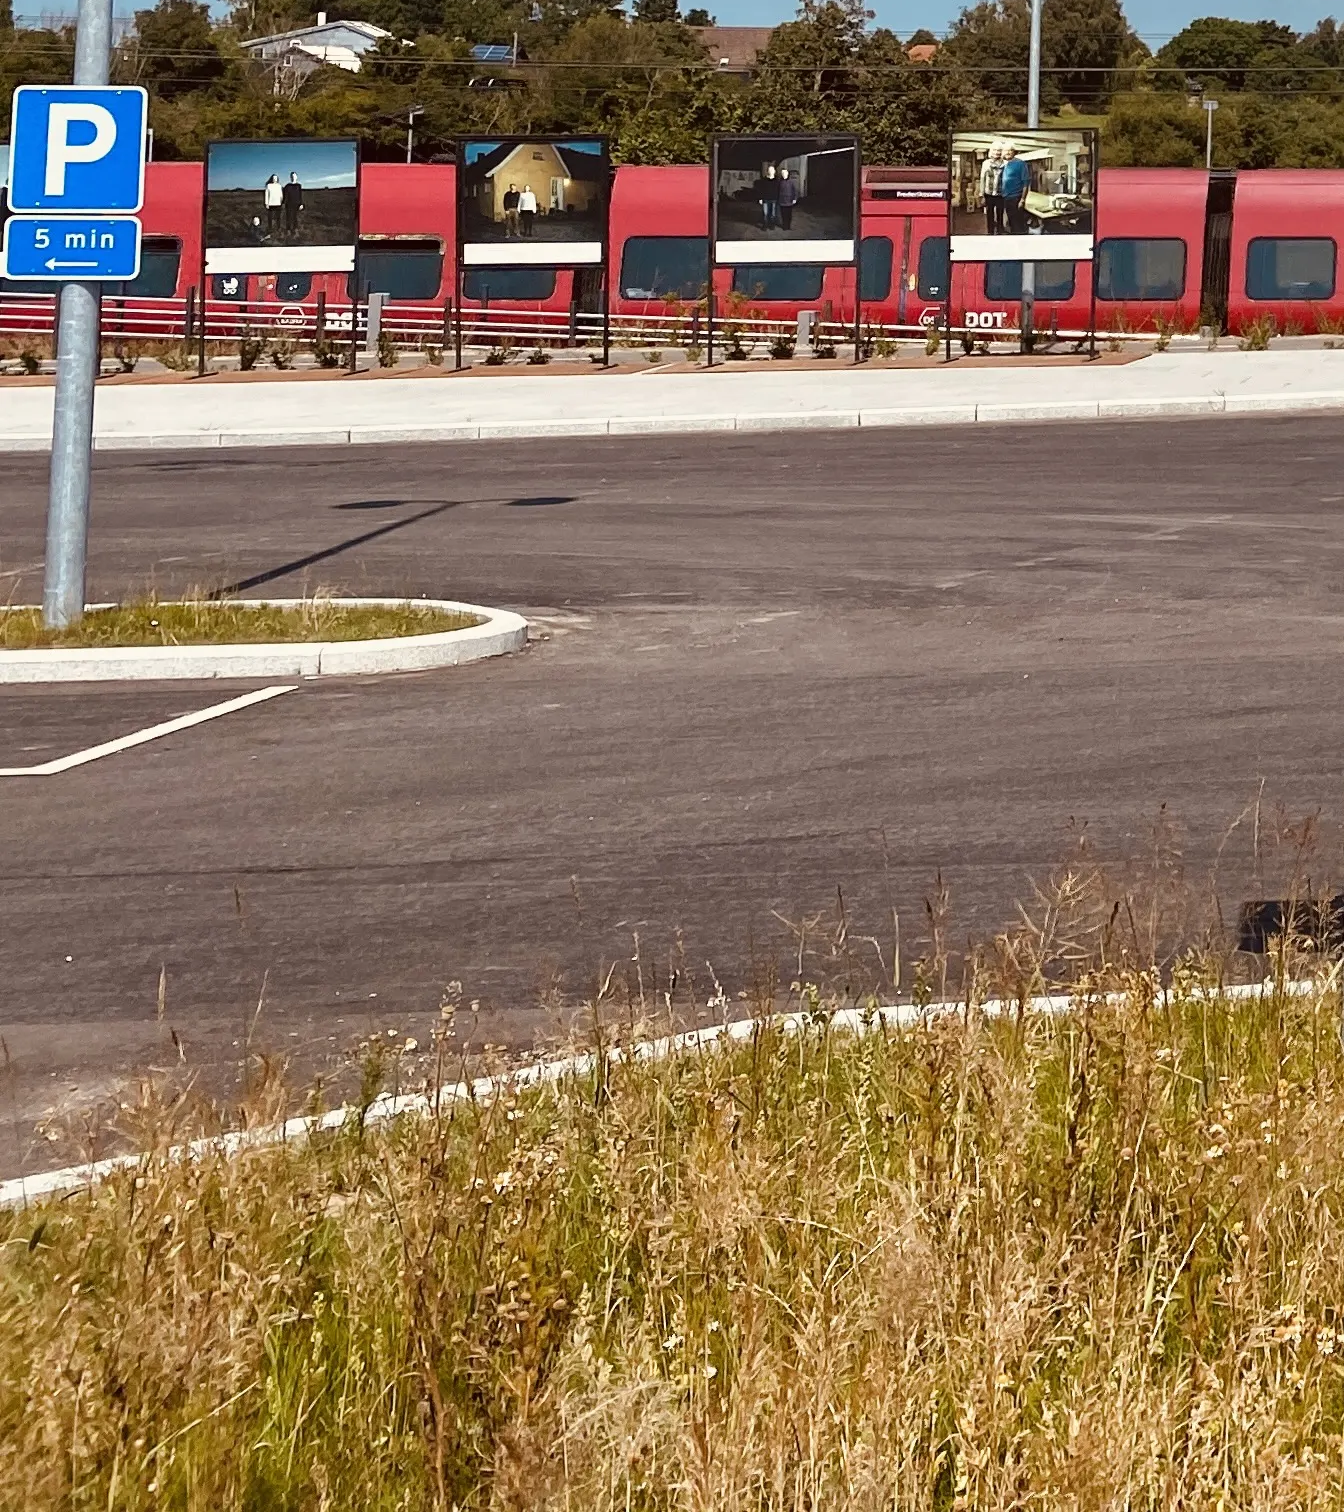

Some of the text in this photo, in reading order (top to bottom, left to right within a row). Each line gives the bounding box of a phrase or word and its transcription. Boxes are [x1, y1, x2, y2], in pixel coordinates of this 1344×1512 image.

[44, 102, 117, 196] P
[34, 228, 114, 249] 5 min
[965, 312, 1007, 328] DOT
